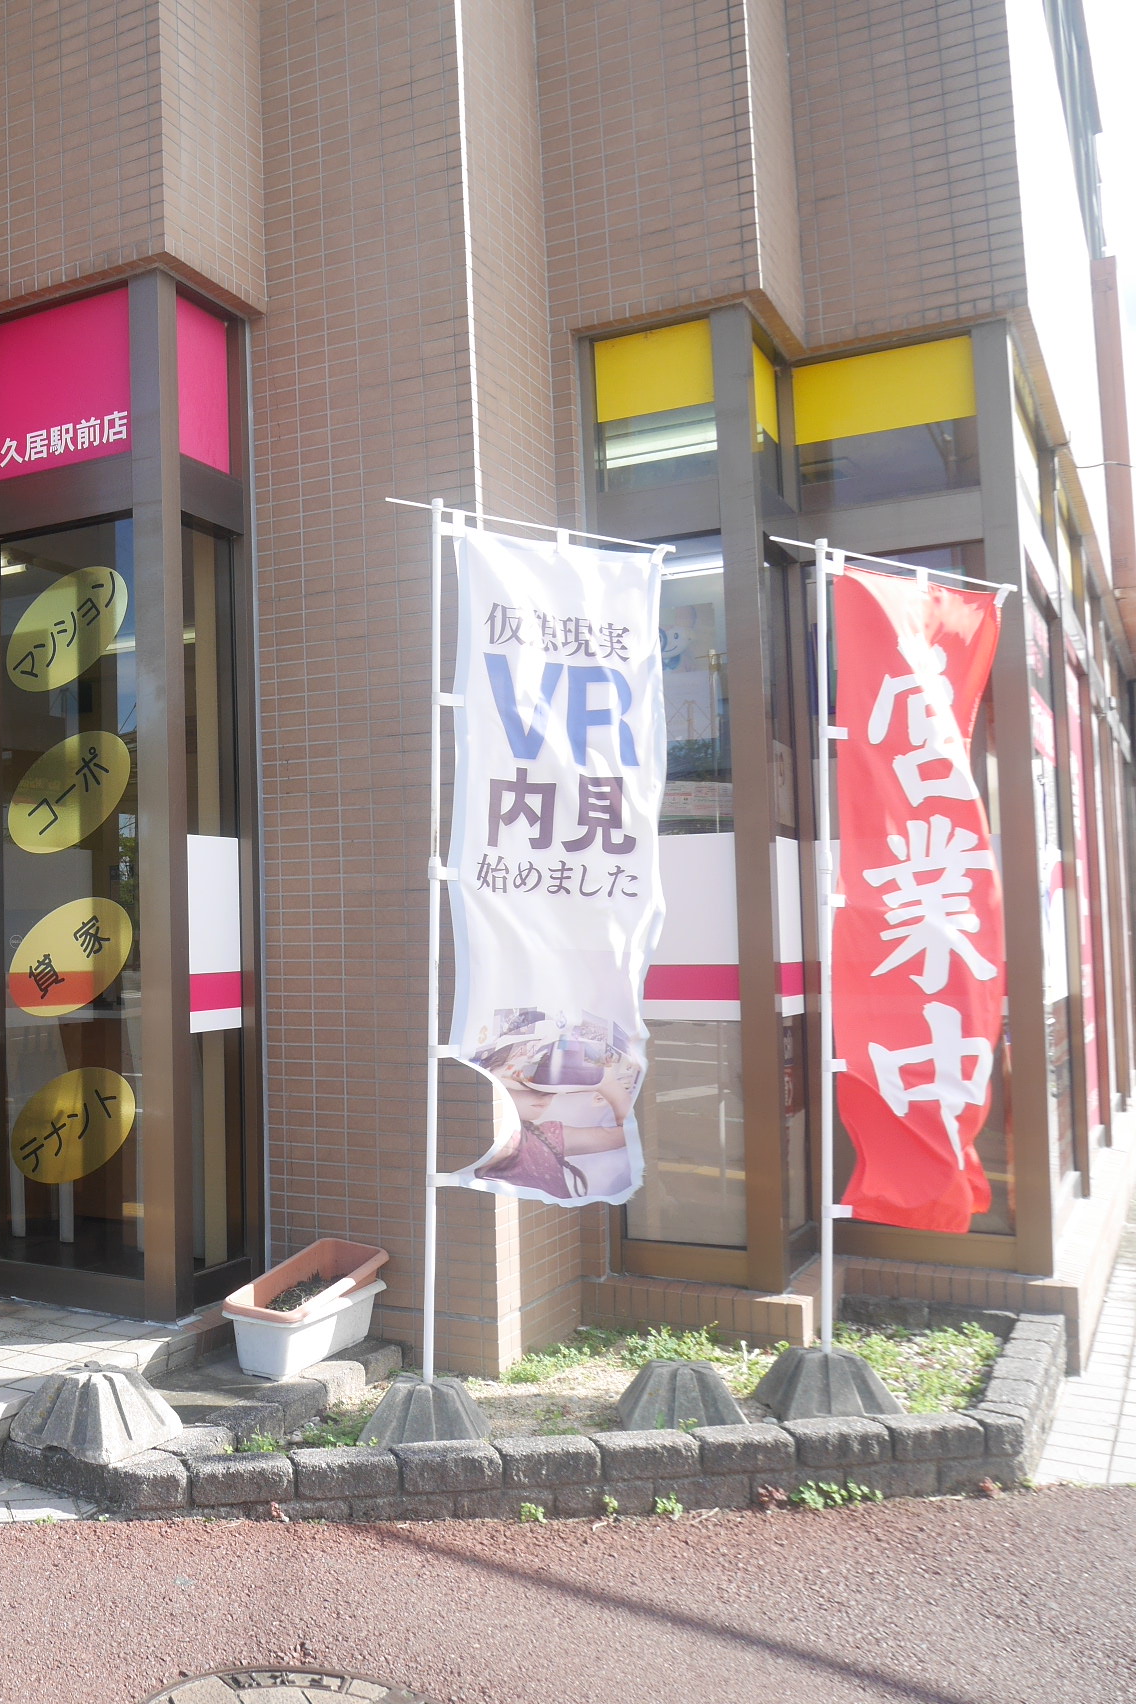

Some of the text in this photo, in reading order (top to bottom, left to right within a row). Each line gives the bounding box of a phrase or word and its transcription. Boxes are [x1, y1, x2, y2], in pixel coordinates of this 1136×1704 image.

[0, 410, 128, 468] 久居駅前店
[13, 571, 116, 678] マンション
[483, 651, 640, 767] VR
[27, 746, 110, 836] コーポ
[487, 767, 637, 855] 内見
[476, 852, 639, 898] 始めました
[862, 635, 997, 1171] 営業中
[28, 915, 111, 1000] 貸家
[20, 1089, 117, 1173] テナント
